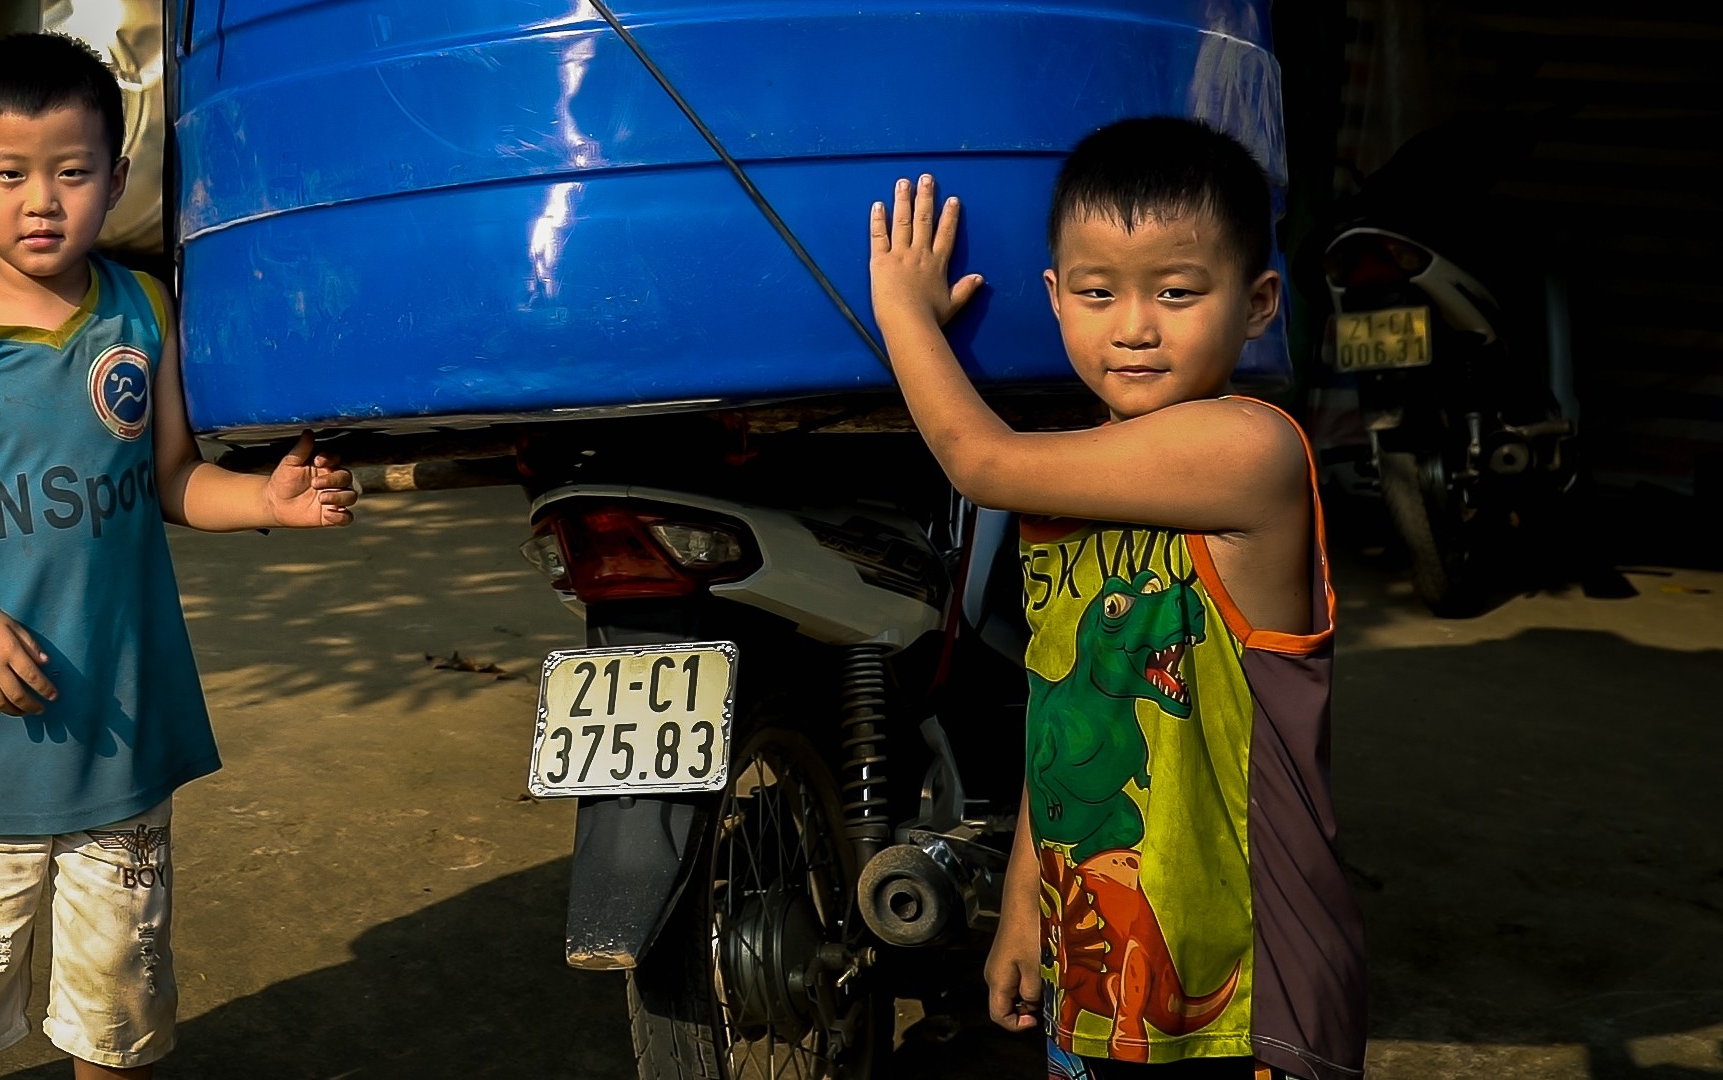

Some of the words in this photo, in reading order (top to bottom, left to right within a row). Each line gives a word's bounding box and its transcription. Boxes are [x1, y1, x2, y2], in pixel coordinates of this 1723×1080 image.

[569, 654, 700, 718] 21-C1
[546, 721, 714, 784] 375.83
[121, 867, 166, 889] BOY
